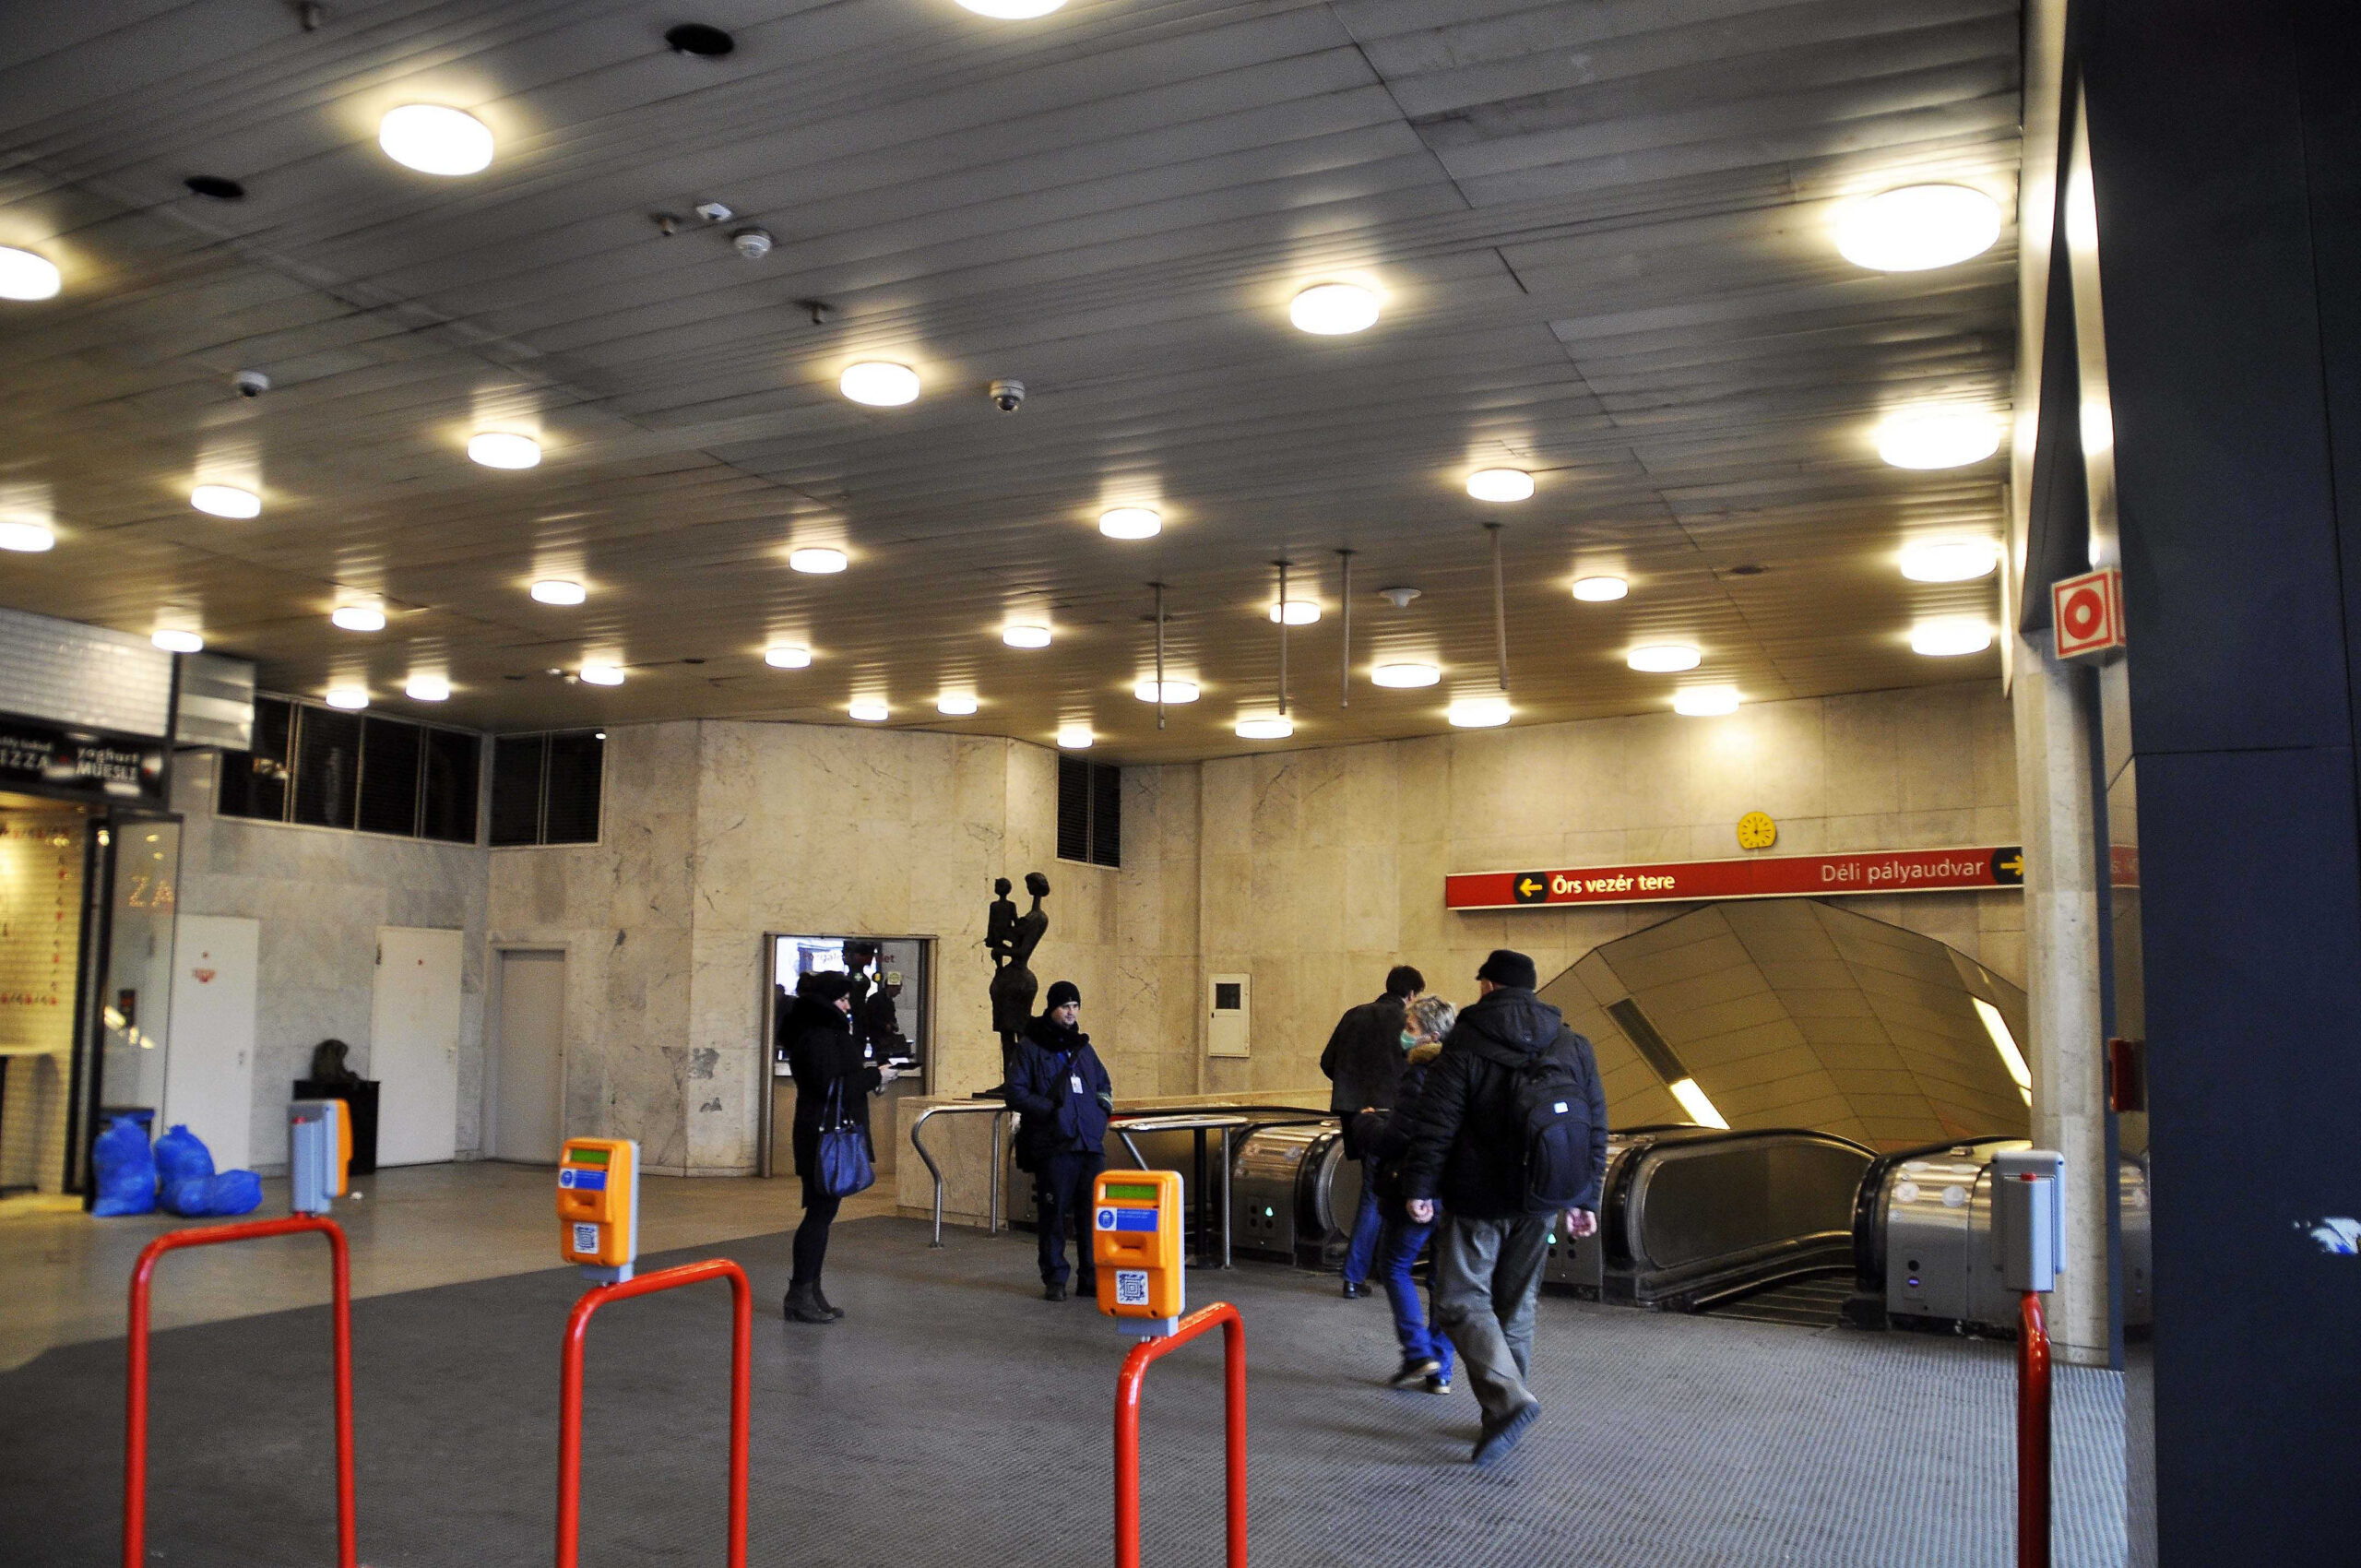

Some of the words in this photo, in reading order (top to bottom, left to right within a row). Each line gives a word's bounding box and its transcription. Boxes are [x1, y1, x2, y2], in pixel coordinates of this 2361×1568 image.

[1552, 874, 1582, 895] Örs
[1585, 873, 1634, 893] vezér
[1638, 874, 1676, 891] tere
[1821, 863, 1861, 882] Déli
[1867, 859, 1985, 885] pályaudvar
